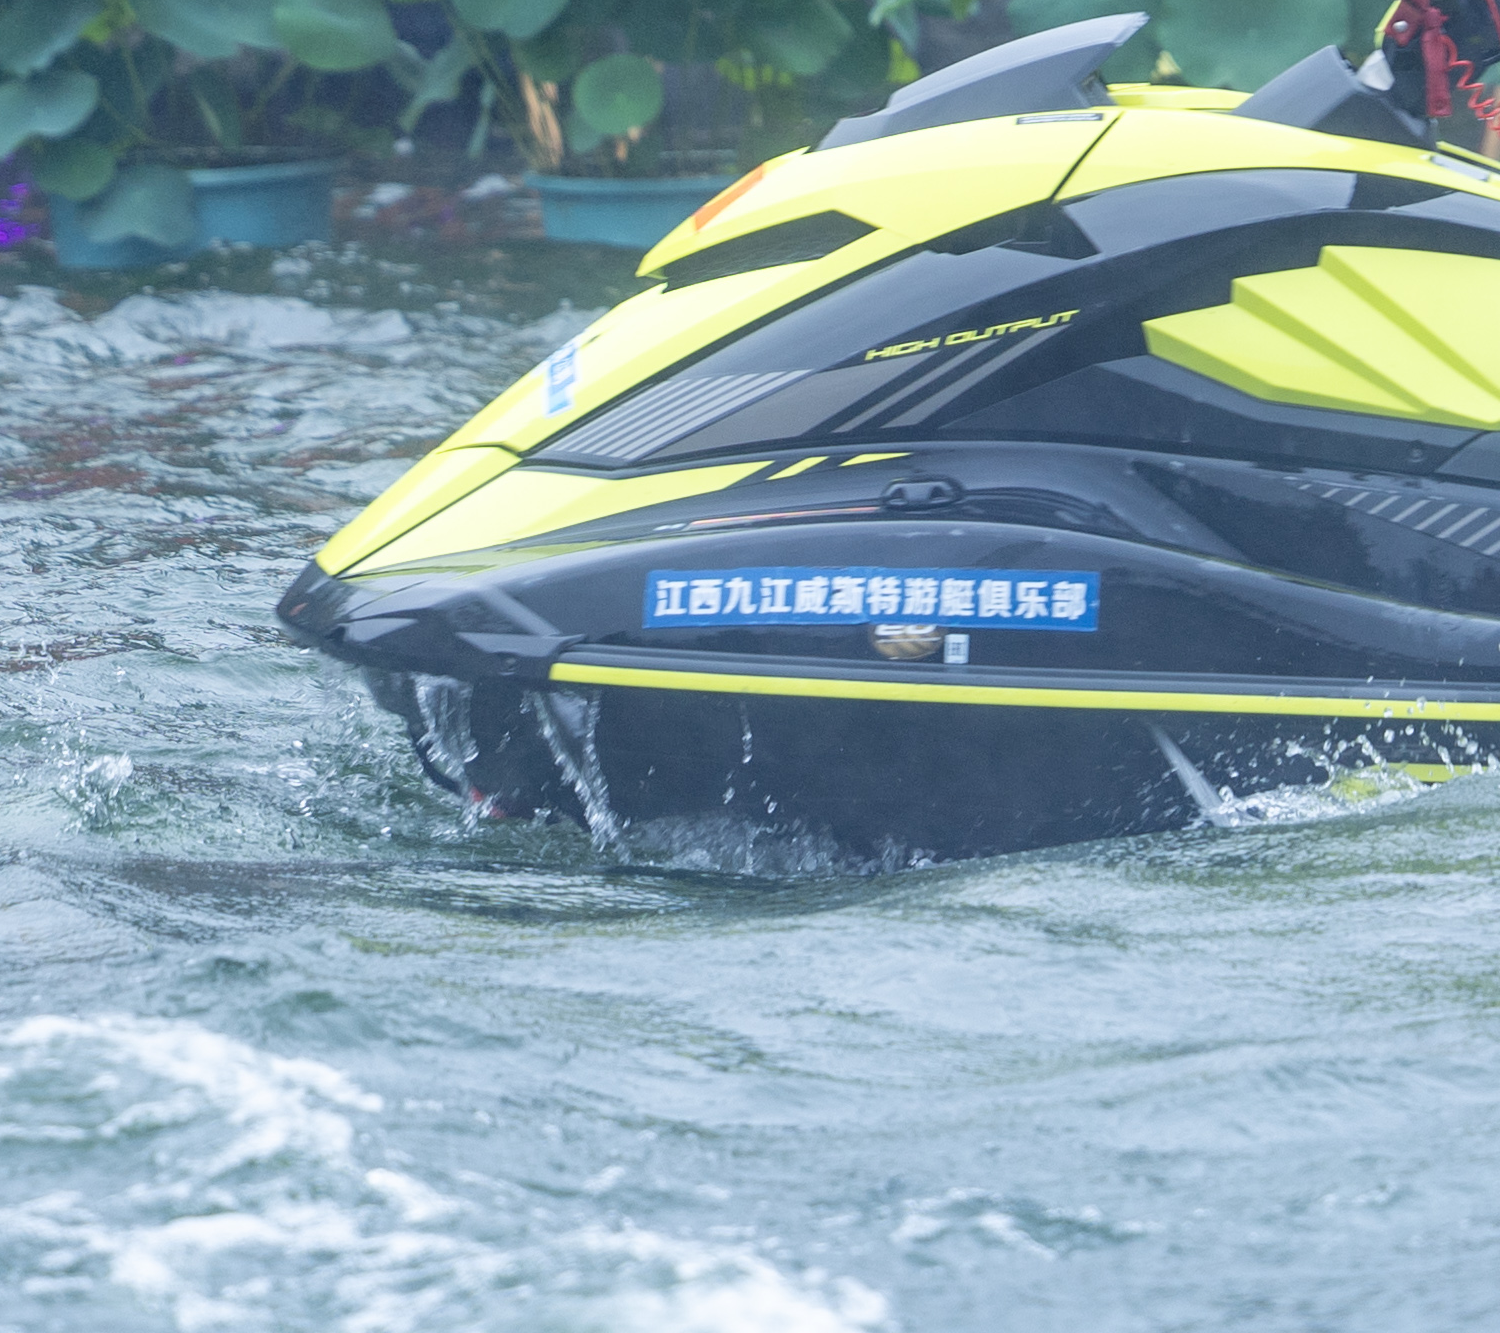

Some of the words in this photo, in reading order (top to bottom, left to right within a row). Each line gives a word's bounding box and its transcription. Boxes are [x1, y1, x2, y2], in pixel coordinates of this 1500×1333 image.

[864, 336, 941, 361] HIGH
[944, 308, 1081, 346] OUTPUT
[653, 576, 1088, 621] 江西九江威斯特游艇俱乐部
